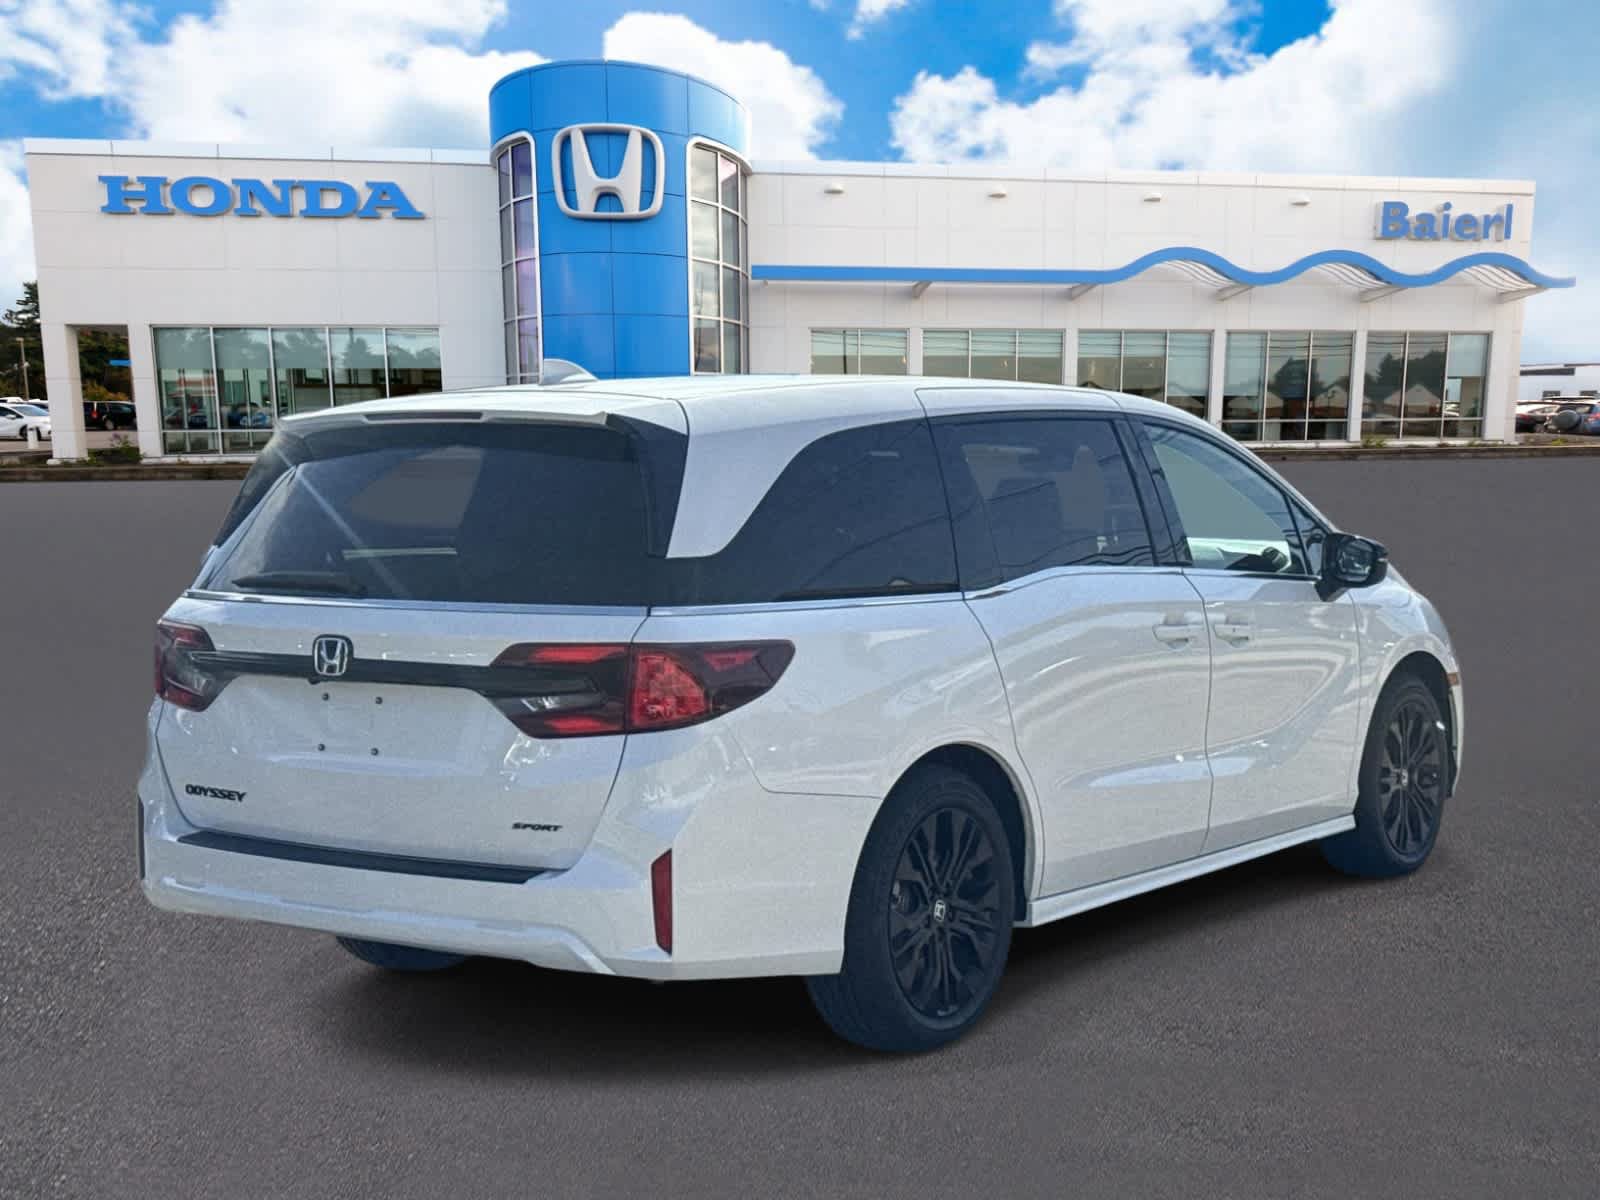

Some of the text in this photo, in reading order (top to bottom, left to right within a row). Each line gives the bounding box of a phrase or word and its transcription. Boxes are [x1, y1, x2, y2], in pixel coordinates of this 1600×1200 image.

[98, 175, 425, 219] HONDA
[1380, 201, 1514, 240] Baierl
[185, 784, 247, 802] ODYSSEY
[512, 822, 563, 832] SPORT
